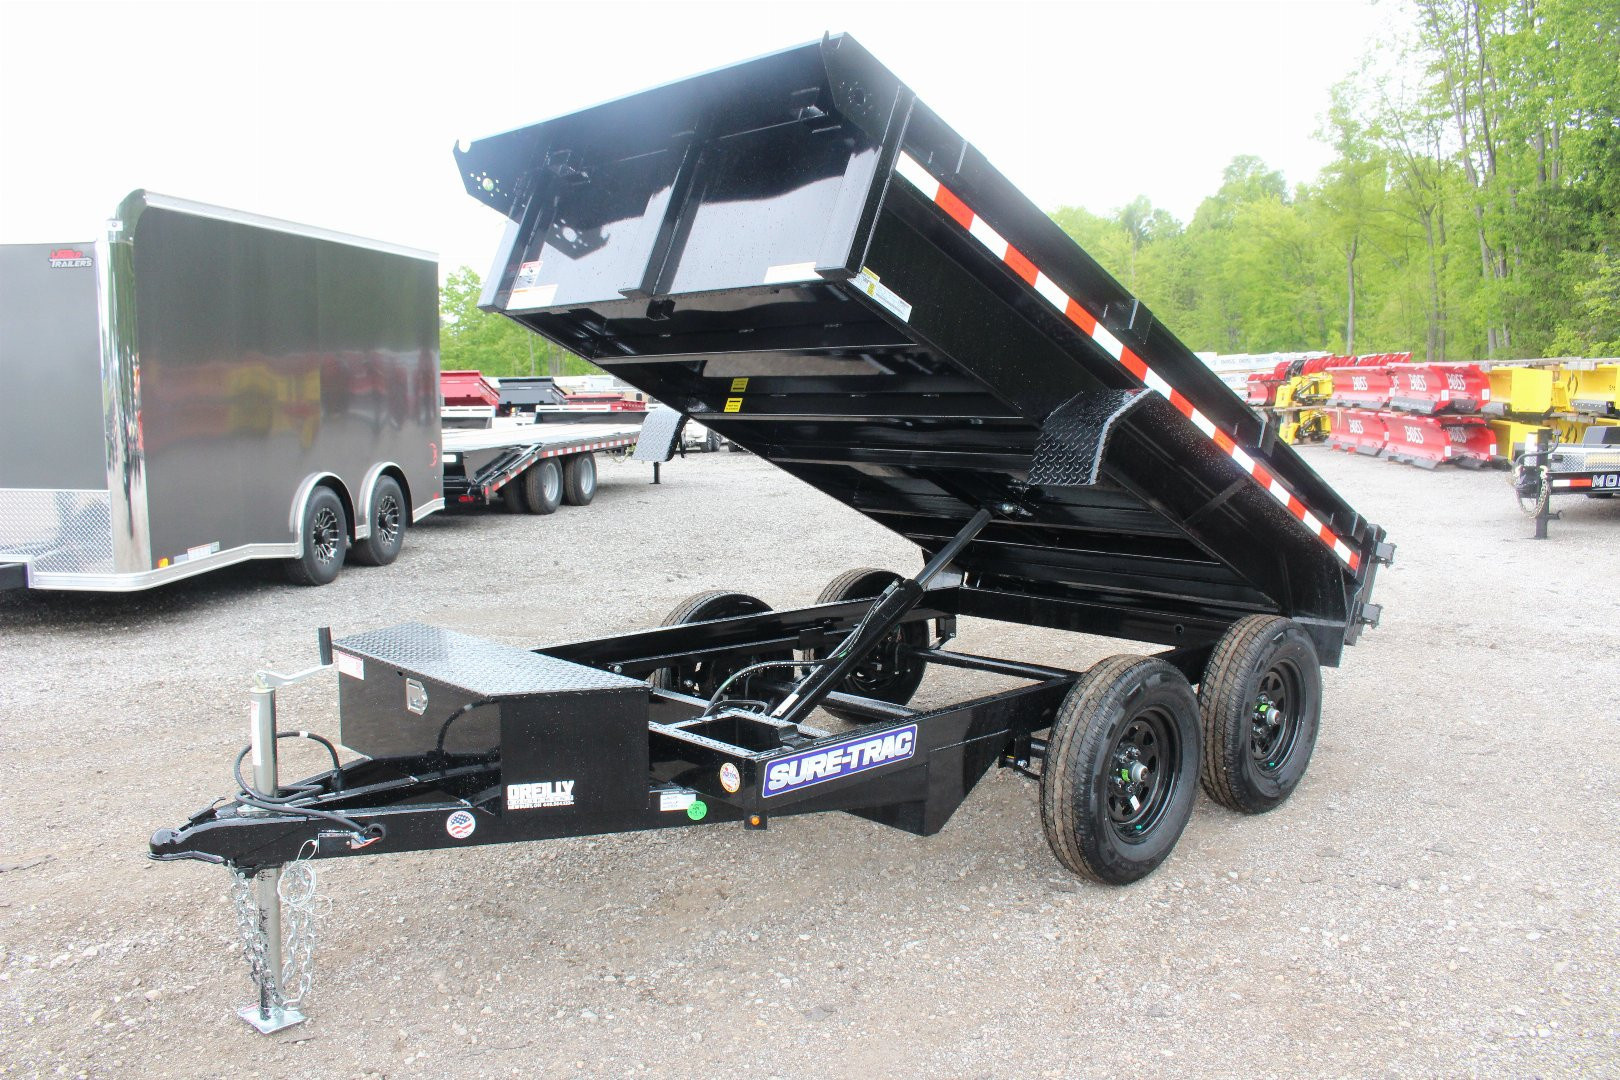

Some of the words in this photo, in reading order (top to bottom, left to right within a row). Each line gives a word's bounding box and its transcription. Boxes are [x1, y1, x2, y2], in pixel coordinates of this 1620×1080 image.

[50, 258, 92, 268] TRAILERS
[1352, 376, 1368, 391] BOSS
[1408, 374, 1427, 391] BOSS
[1446, 373, 1466, 391] BOSS
[1348, 419, 1364, 434] BOSS
[1404, 425, 1424, 444] BOSS
[1592, 474, 1620, 488] MO
[768, 732, 913, 791] SURE-TRAC
